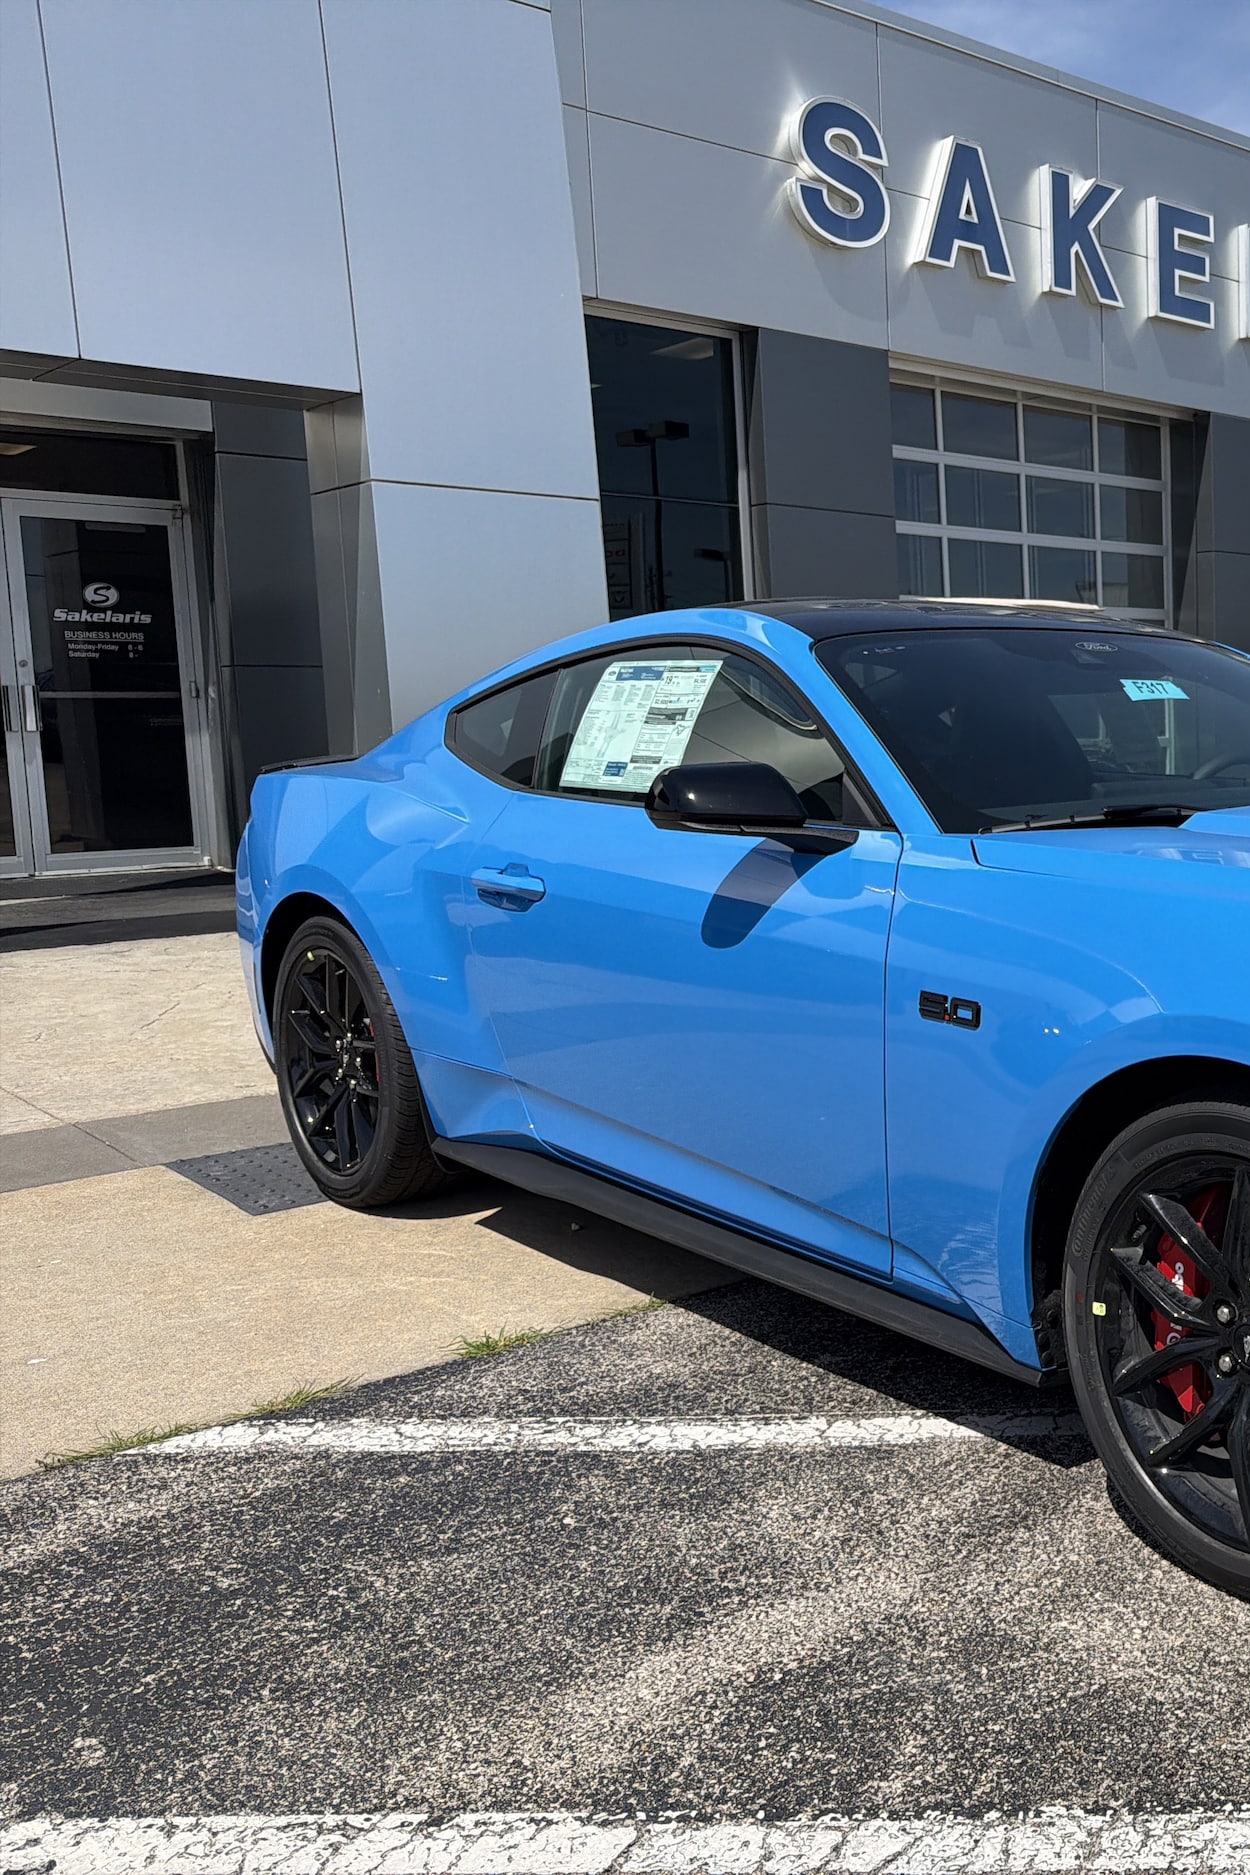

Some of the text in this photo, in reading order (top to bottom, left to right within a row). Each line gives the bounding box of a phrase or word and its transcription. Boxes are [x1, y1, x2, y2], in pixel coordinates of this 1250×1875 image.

[53, 608, 152, 624] Sakelaris
[64, 630, 144, 641] BUSINESS HOURS
[69, 650, 100, 658] Saturday
[1132, 681, 1168, 695] F317
[918, 990, 982, 1032] 5.0
